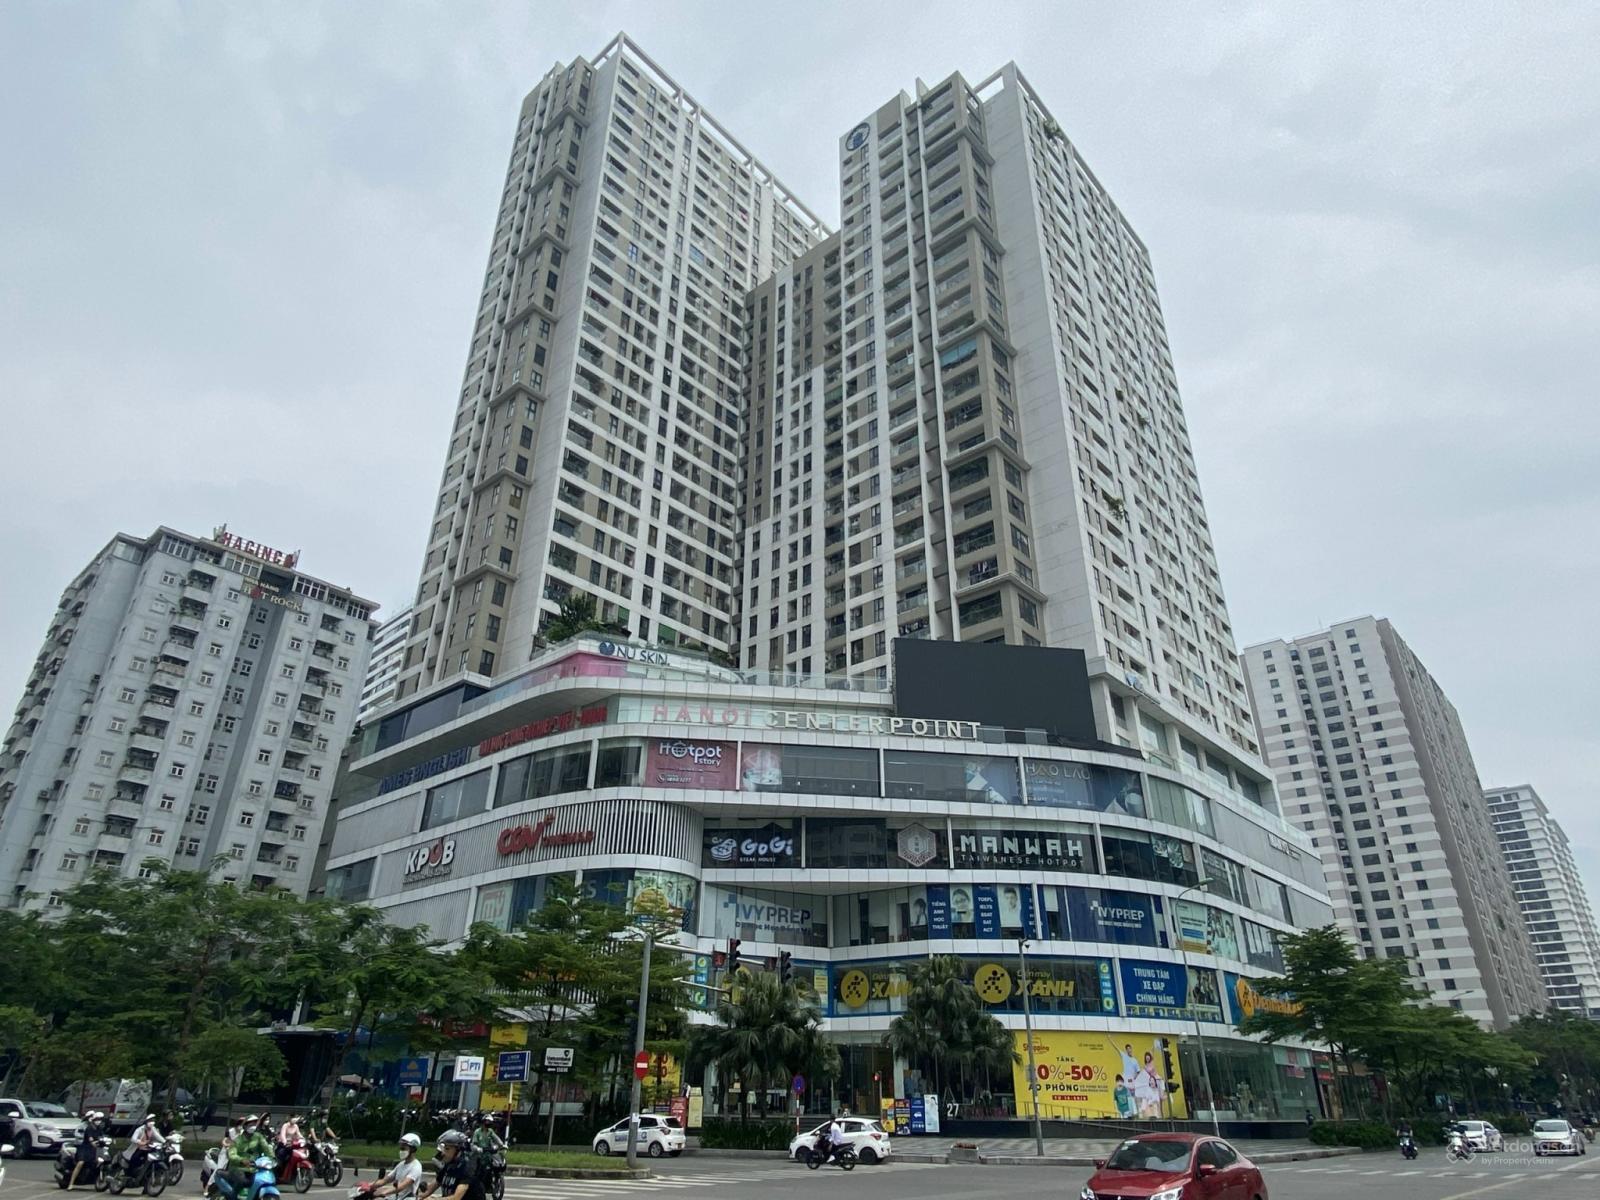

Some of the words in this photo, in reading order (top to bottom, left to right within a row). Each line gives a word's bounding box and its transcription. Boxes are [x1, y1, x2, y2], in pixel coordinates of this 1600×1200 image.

[616, 646, 636, 660] NU
[763, 710, 981, 742] CENTERPOINT
[659, 741, 722, 764] Hotpot
[698, 758, 721, 767] story
[959, 834, 1083, 857] MANWAH
[961, 854, 1031, 864] TAIWANESE
[1038, 857, 1084, 867] HOTPOT
[735, 903, 812, 925] IVYPREP
[1098, 906, 1145, 921] IVYPREP
[1133, 967, 1156, 978] TRUNG
[1014, 979, 1075, 997] XANH
[1142, 980, 1152, 990] XE
[1029, 1064, 1108, 1082] 0%-50%
[946, 1103, 960, 1118] 27
